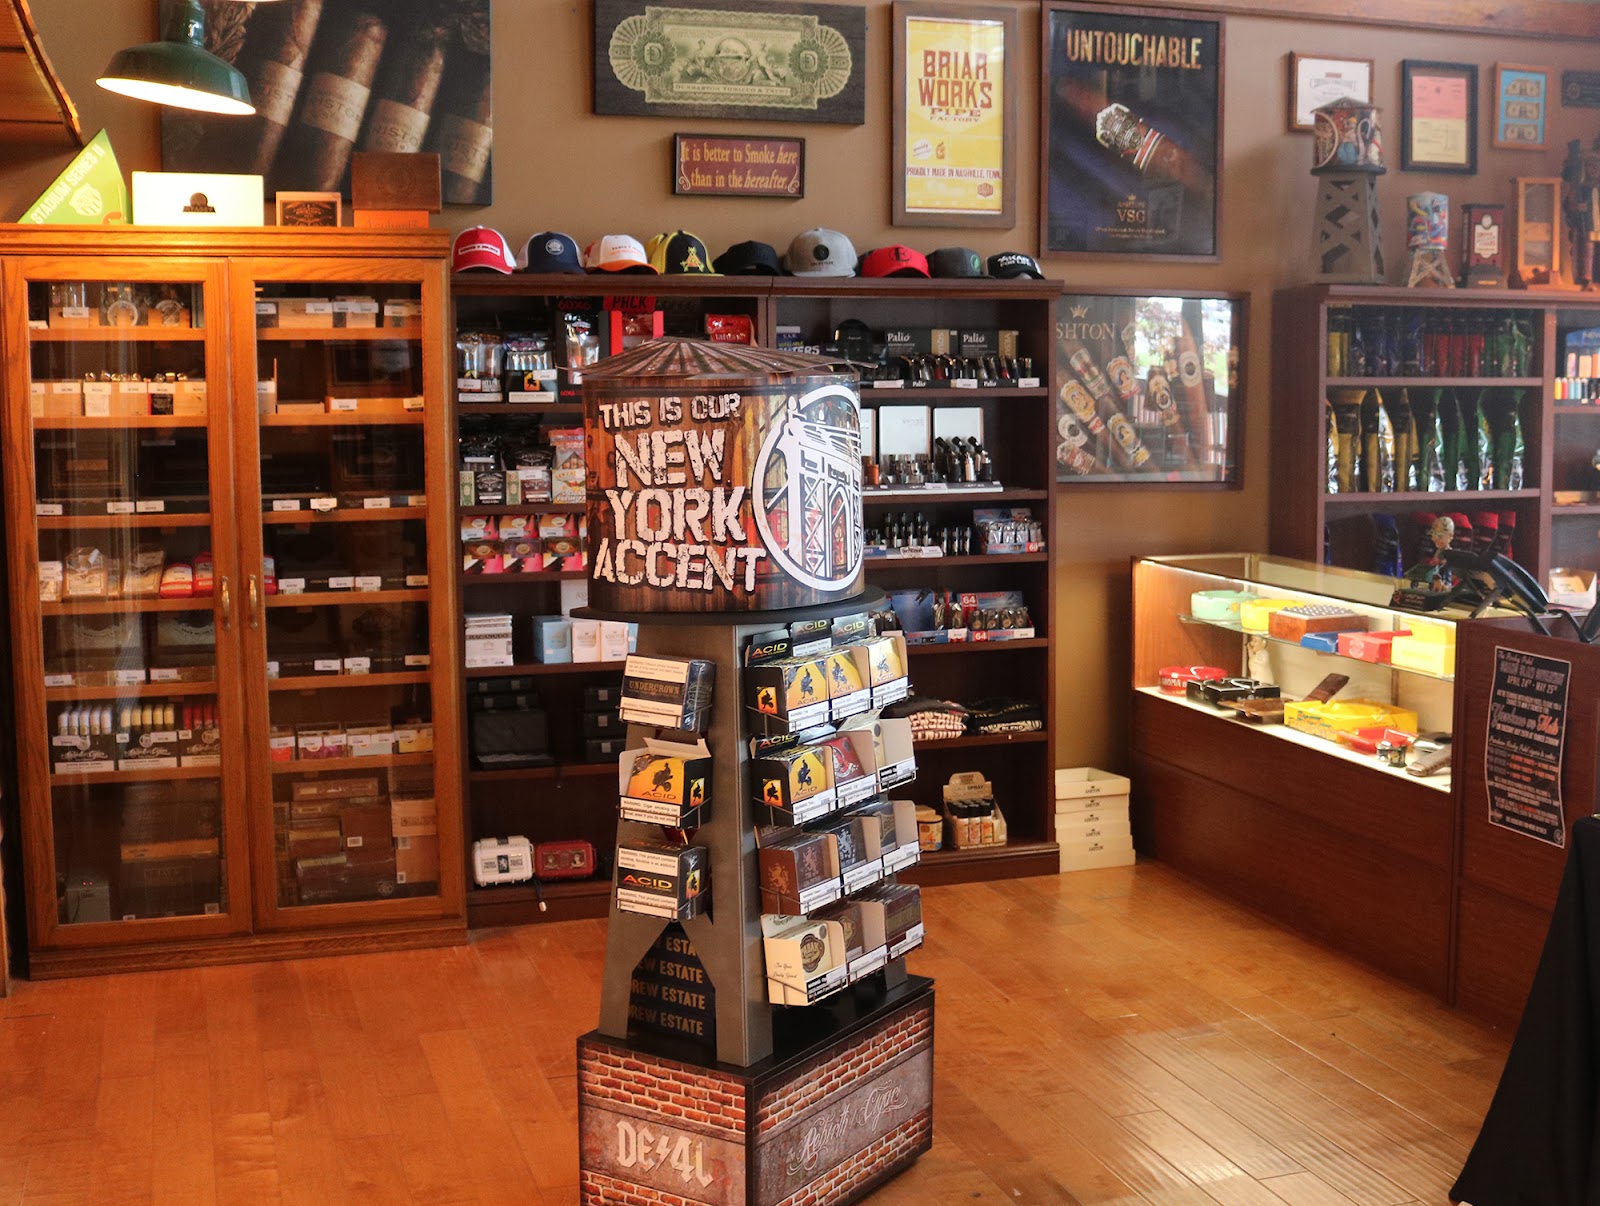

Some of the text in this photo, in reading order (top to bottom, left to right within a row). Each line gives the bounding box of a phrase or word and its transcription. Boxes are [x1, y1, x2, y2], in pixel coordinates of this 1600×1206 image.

[1067, 28, 1202, 69] UNTOUCHABLE
[924, 50, 988, 80] BRIAR
[918, 78, 992, 108] WORKS
[931, 108, 980, 116] PIPE
[681, 141, 798, 164] It is better to Smoke here
[691, 167, 788, 190] than in the hereafter.
[906, 167, 930, 176] PROUDLY
[932, 168, 946, 177] MADE
[948, 168, 954, 177] IN
[956, 168, 984, 178] NASHVILLE,
[31, 181, 72, 224] STADIUM
[65, 152, 98, 187] SERIES
[1116, 208, 1146, 222] VSG
[1056, 322, 1114, 340] SHTON
[937, 332, 945, 356] SQUA
[599, 392, 742, 429] THIS IS OUR
[615, 428, 726, 488] NEW
[605, 486, 747, 543] YORK
[593, 538, 766, 592] ACCENT
[795, 620, 828, 634] ACID
[834, 621, 865, 636] ACID
[752, 642, 788, 658] ACID
[875, 673, 894, 682] ACID
[629, 680, 680, 696] UNDERCROWN
[834, 684, 854, 694] ACID
[796, 696, 818, 706] ACID
[759, 734, 795, 749] ACID
[642, 790, 676, 800] ACID
[793, 786, 818, 798] ACID
[623, 874, 672, 890] ACID
[666, 937, 697, 956] ESTA
[660, 960, 704, 984] ESTATE
[632, 979, 706, 1010] REW ESTATE
[630, 1004, 704, 1036] REW ESTATE
